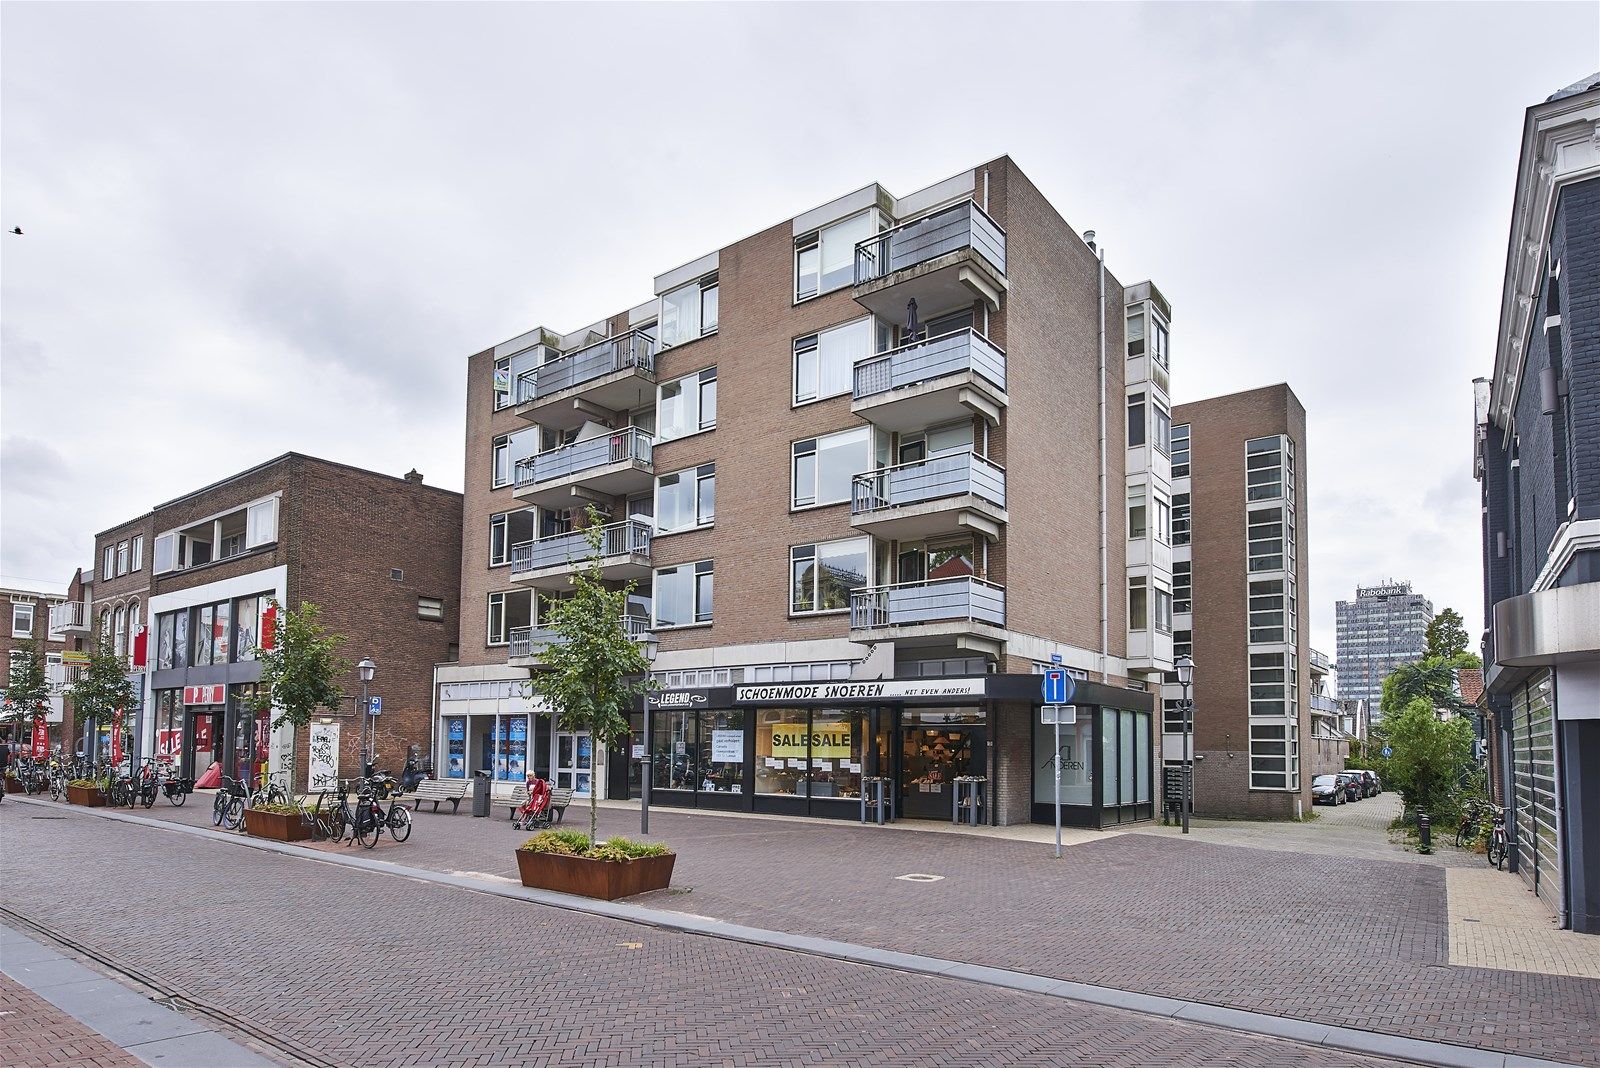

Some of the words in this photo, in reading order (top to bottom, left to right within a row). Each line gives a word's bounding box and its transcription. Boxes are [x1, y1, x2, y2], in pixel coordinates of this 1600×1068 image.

[1360, 587, 1402, 597] Rabobank
[660, 692, 690, 703] LEGEND
[740, 686, 819, 700] SCHOENMODE
[825, 683, 885, 698] SNOEREN
[942, 687, 971, 695] ANDERS!
[772, 733, 808, 747] SALE
[811, 733, 851, 747] SALE
